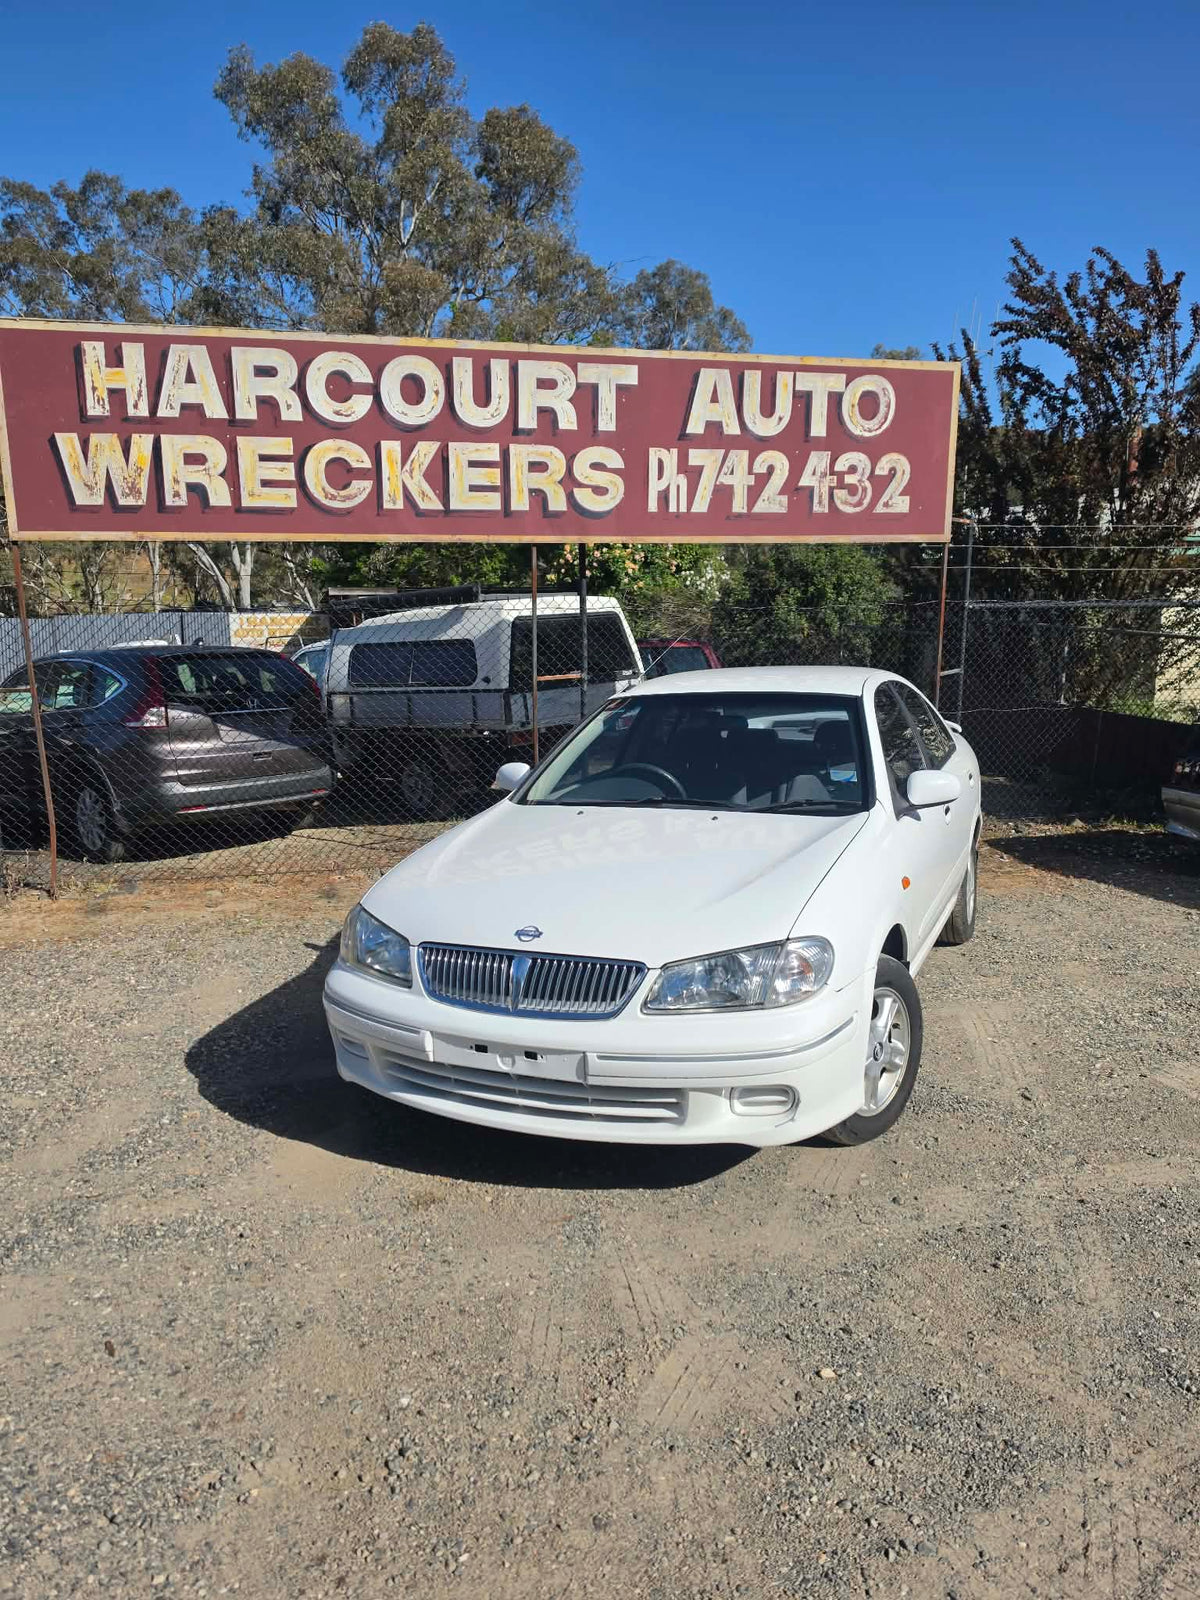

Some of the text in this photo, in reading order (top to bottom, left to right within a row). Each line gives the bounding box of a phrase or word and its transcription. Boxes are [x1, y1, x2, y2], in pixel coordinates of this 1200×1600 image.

[80, 341, 896, 437] HARCOURT AUTO
[53, 433, 625, 513] WRECKERS
